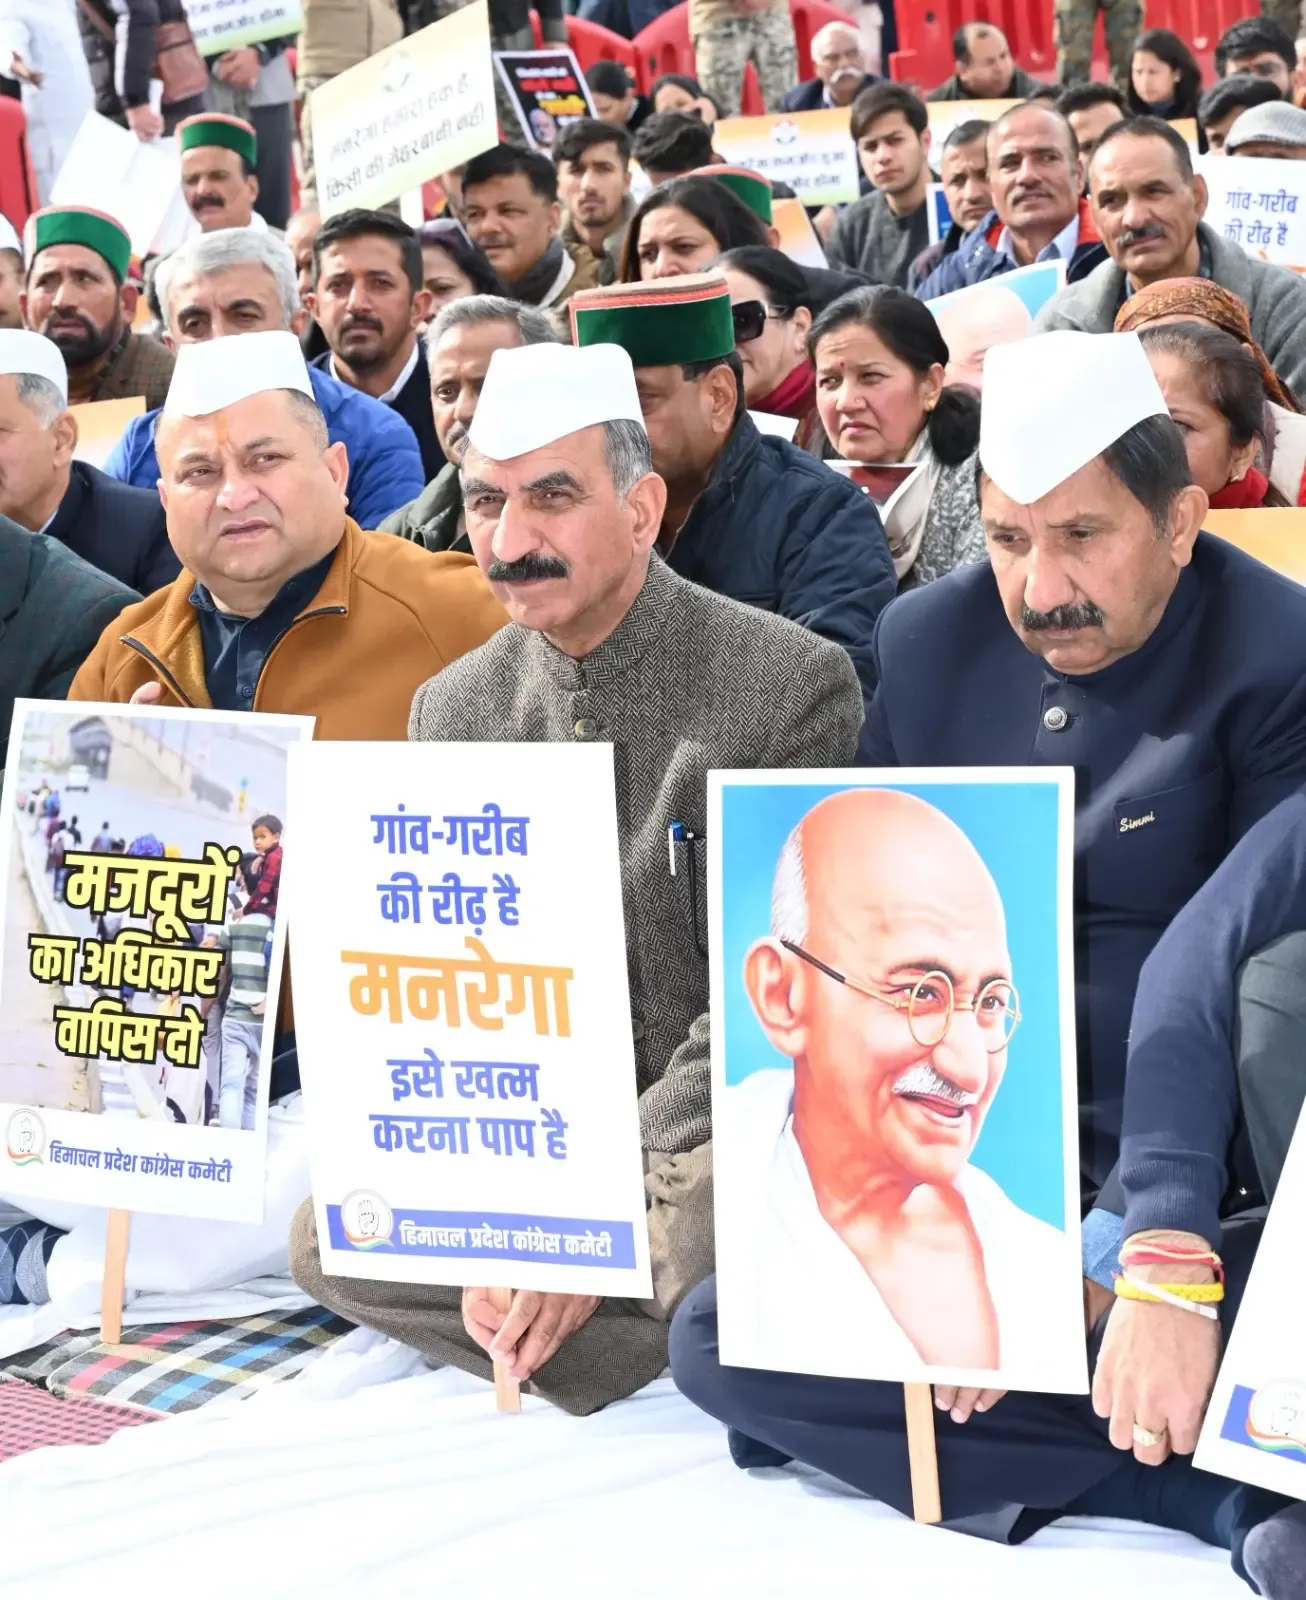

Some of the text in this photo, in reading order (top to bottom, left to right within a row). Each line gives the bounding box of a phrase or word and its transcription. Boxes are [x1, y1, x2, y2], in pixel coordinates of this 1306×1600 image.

[326, 166, 363, 200] किसी
[366, 153, 384, 179] की
[1224, 218, 1243, 243] की
[1276, 221, 1289, 246] है
[369, 803, 531, 857] गांव-गरीब
[1119, 810, 1156, 833] Simmi
[64, 843, 240, 942] मजदूरों
[376, 871, 521, 936] की रीढ़ है
[31, 931, 224, 996] का अधिकार
[339, 935, 575, 1038] मनरेगा
[56, 1001, 206, 1068] वापिस दो
[385, 1047, 540, 1103] इसे खत्म
[50, 1140, 233, 1183] हिमाचल प्रदेश कांग्रेस कमेटी
[368, 1108, 568, 1161] करना पाप है
[398, 1219, 613, 1258] हिमाचल प्रदेश कांग्रेस कमेटी
